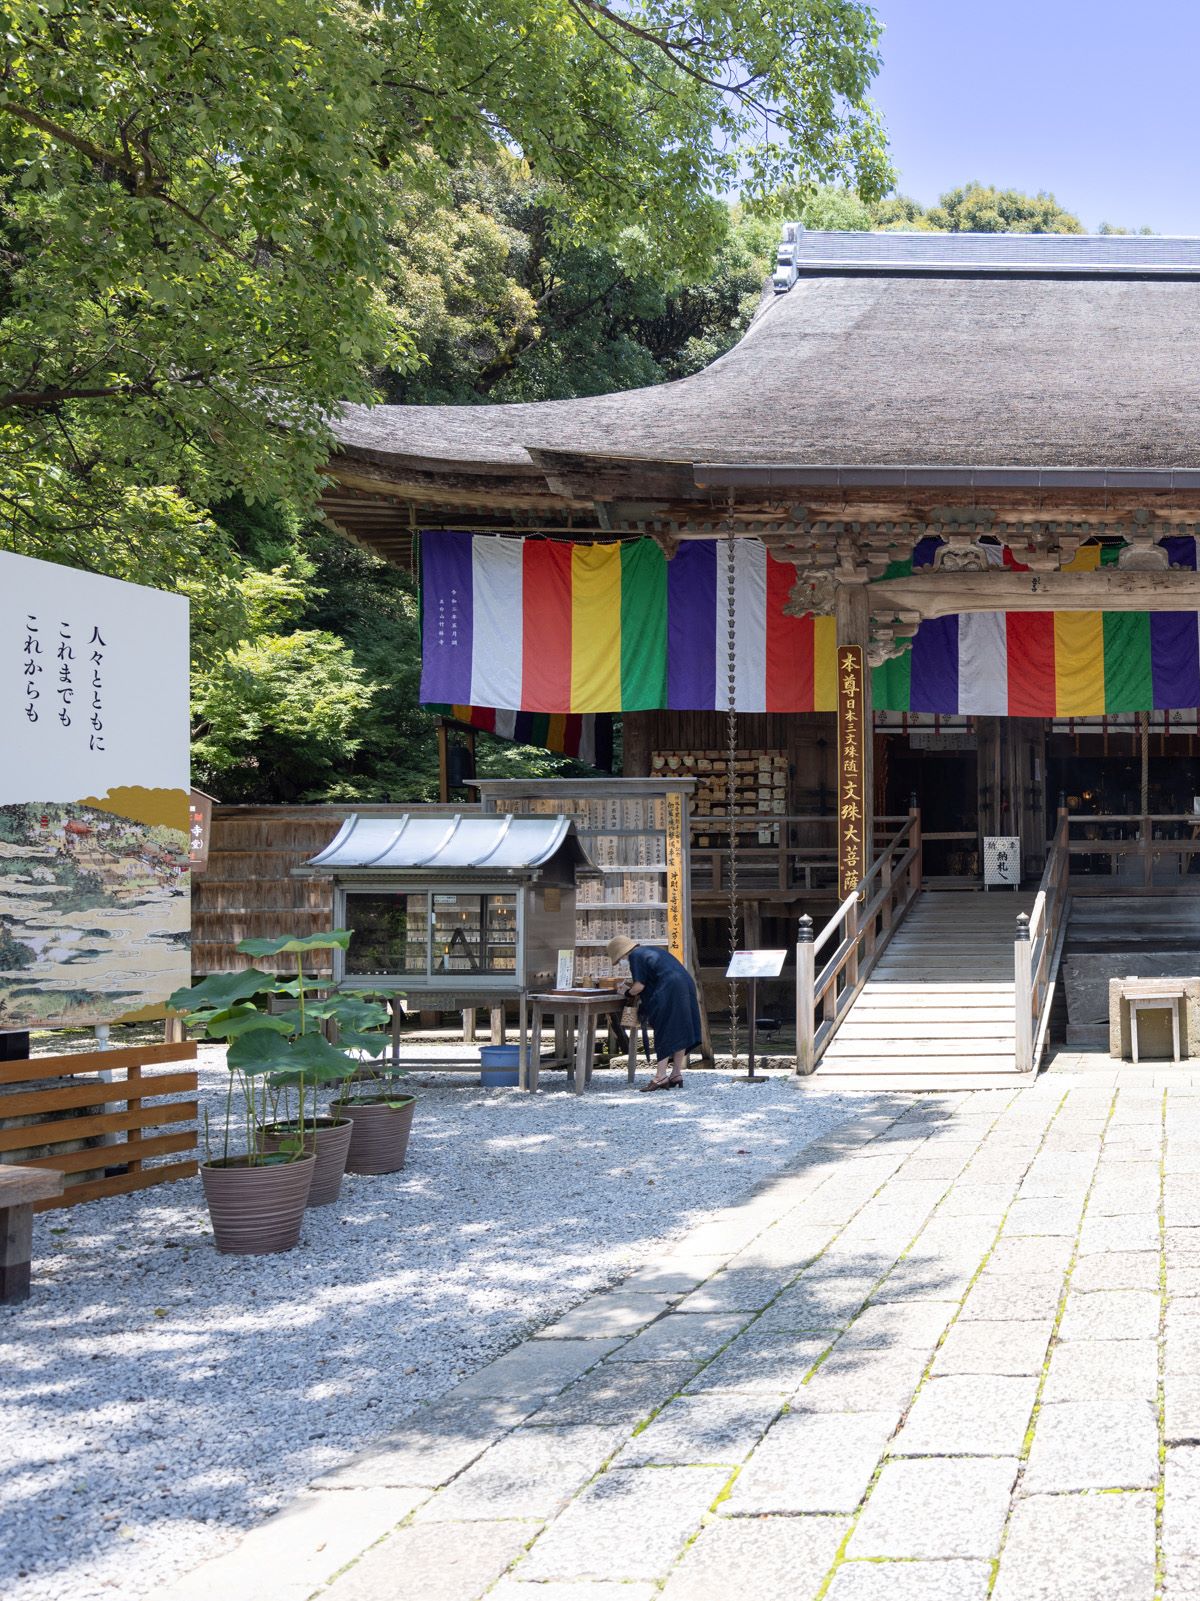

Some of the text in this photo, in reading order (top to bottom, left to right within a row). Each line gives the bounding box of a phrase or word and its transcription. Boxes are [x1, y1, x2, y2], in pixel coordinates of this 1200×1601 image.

[24, 614, 43, 723] これからも
[57, 621, 76, 728] これまでも
[89, 625, 107, 752] 人々とともに
